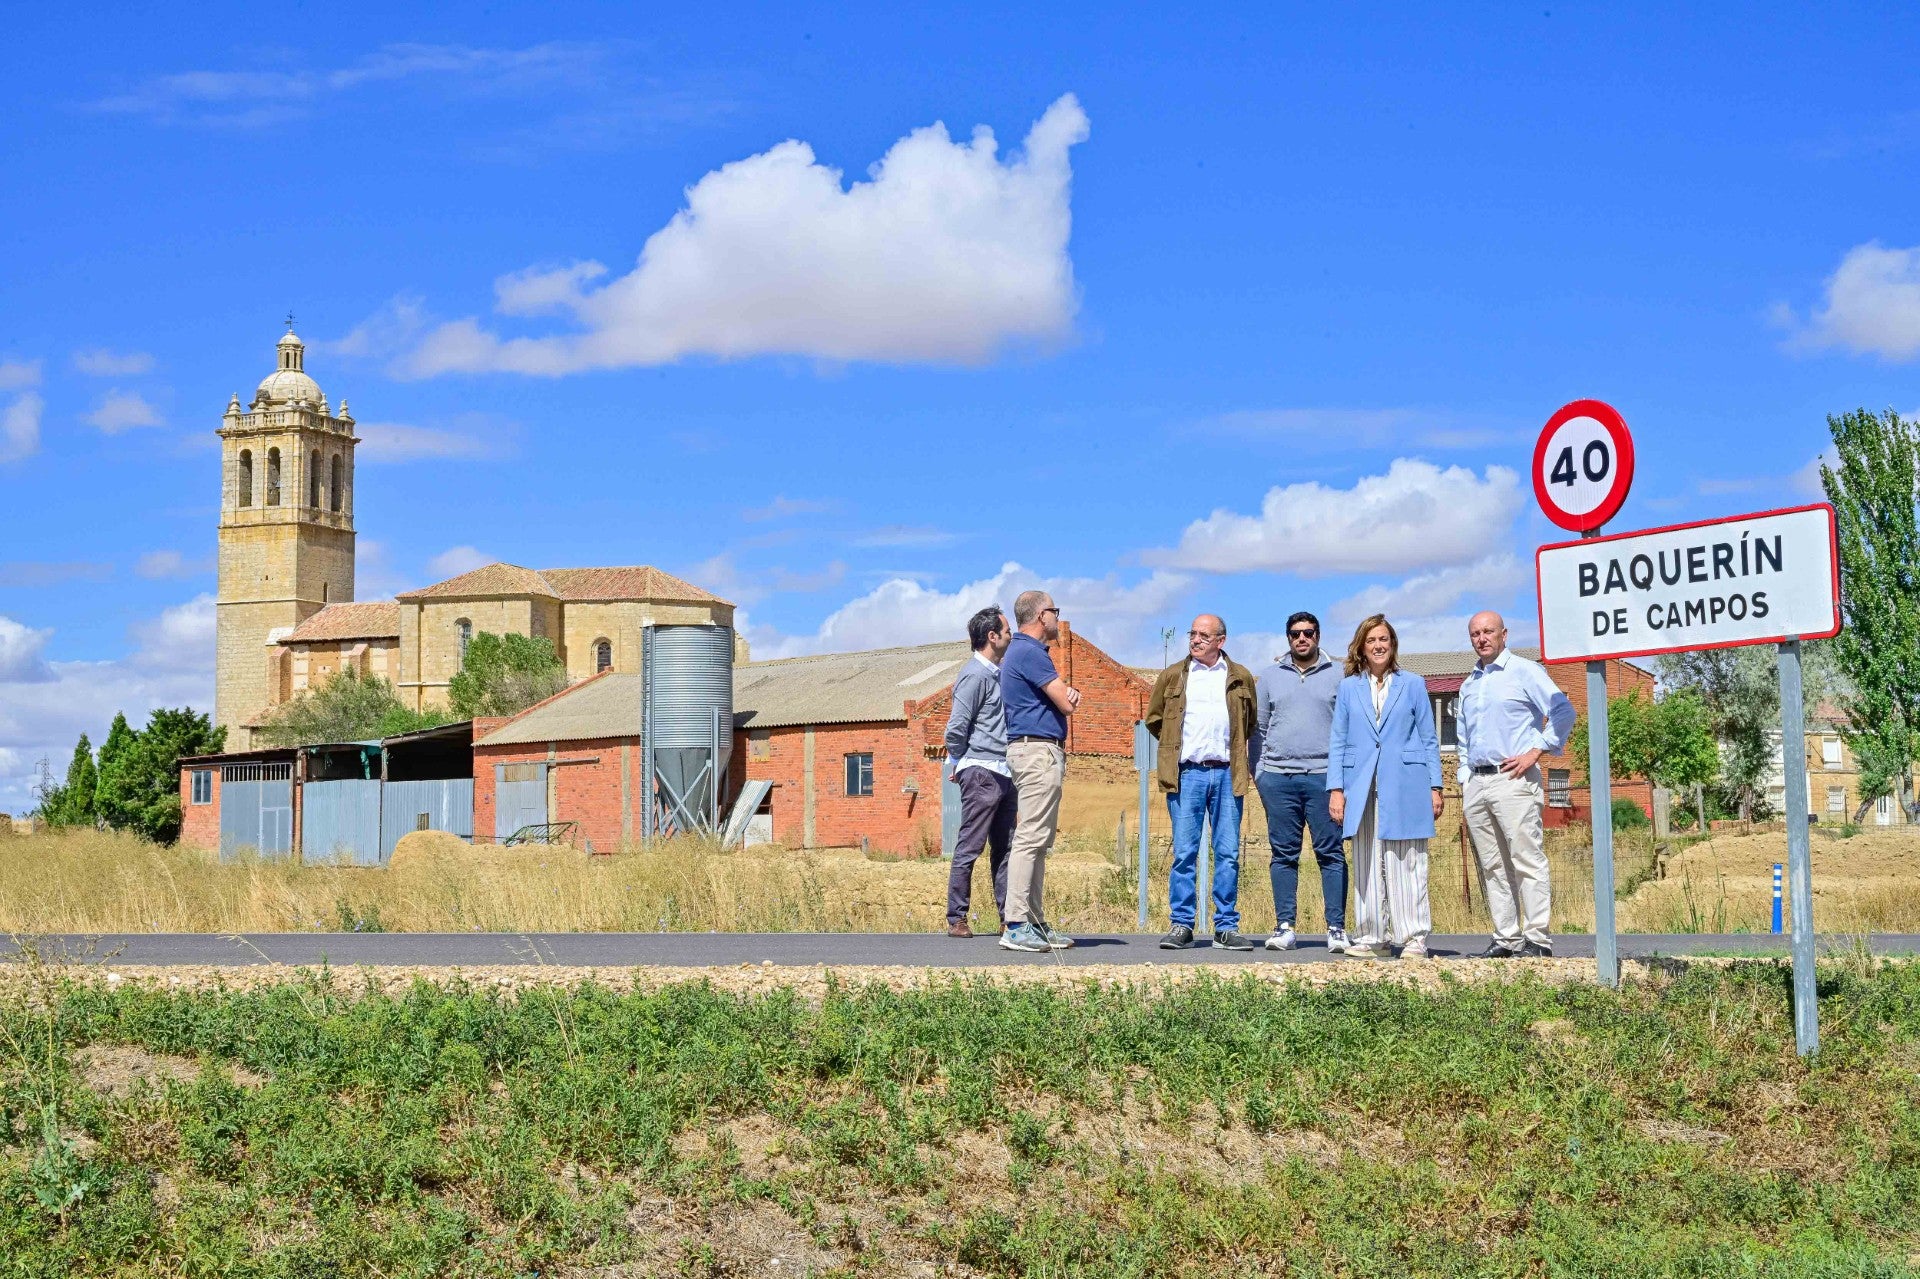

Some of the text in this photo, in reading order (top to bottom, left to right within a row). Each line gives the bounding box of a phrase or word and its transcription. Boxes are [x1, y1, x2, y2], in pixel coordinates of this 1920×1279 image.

[1550, 439, 1610, 487] 40
[1578, 531, 1784, 598] BAQUERÍN
[1592, 591, 1770, 637] DE CAMPOS
